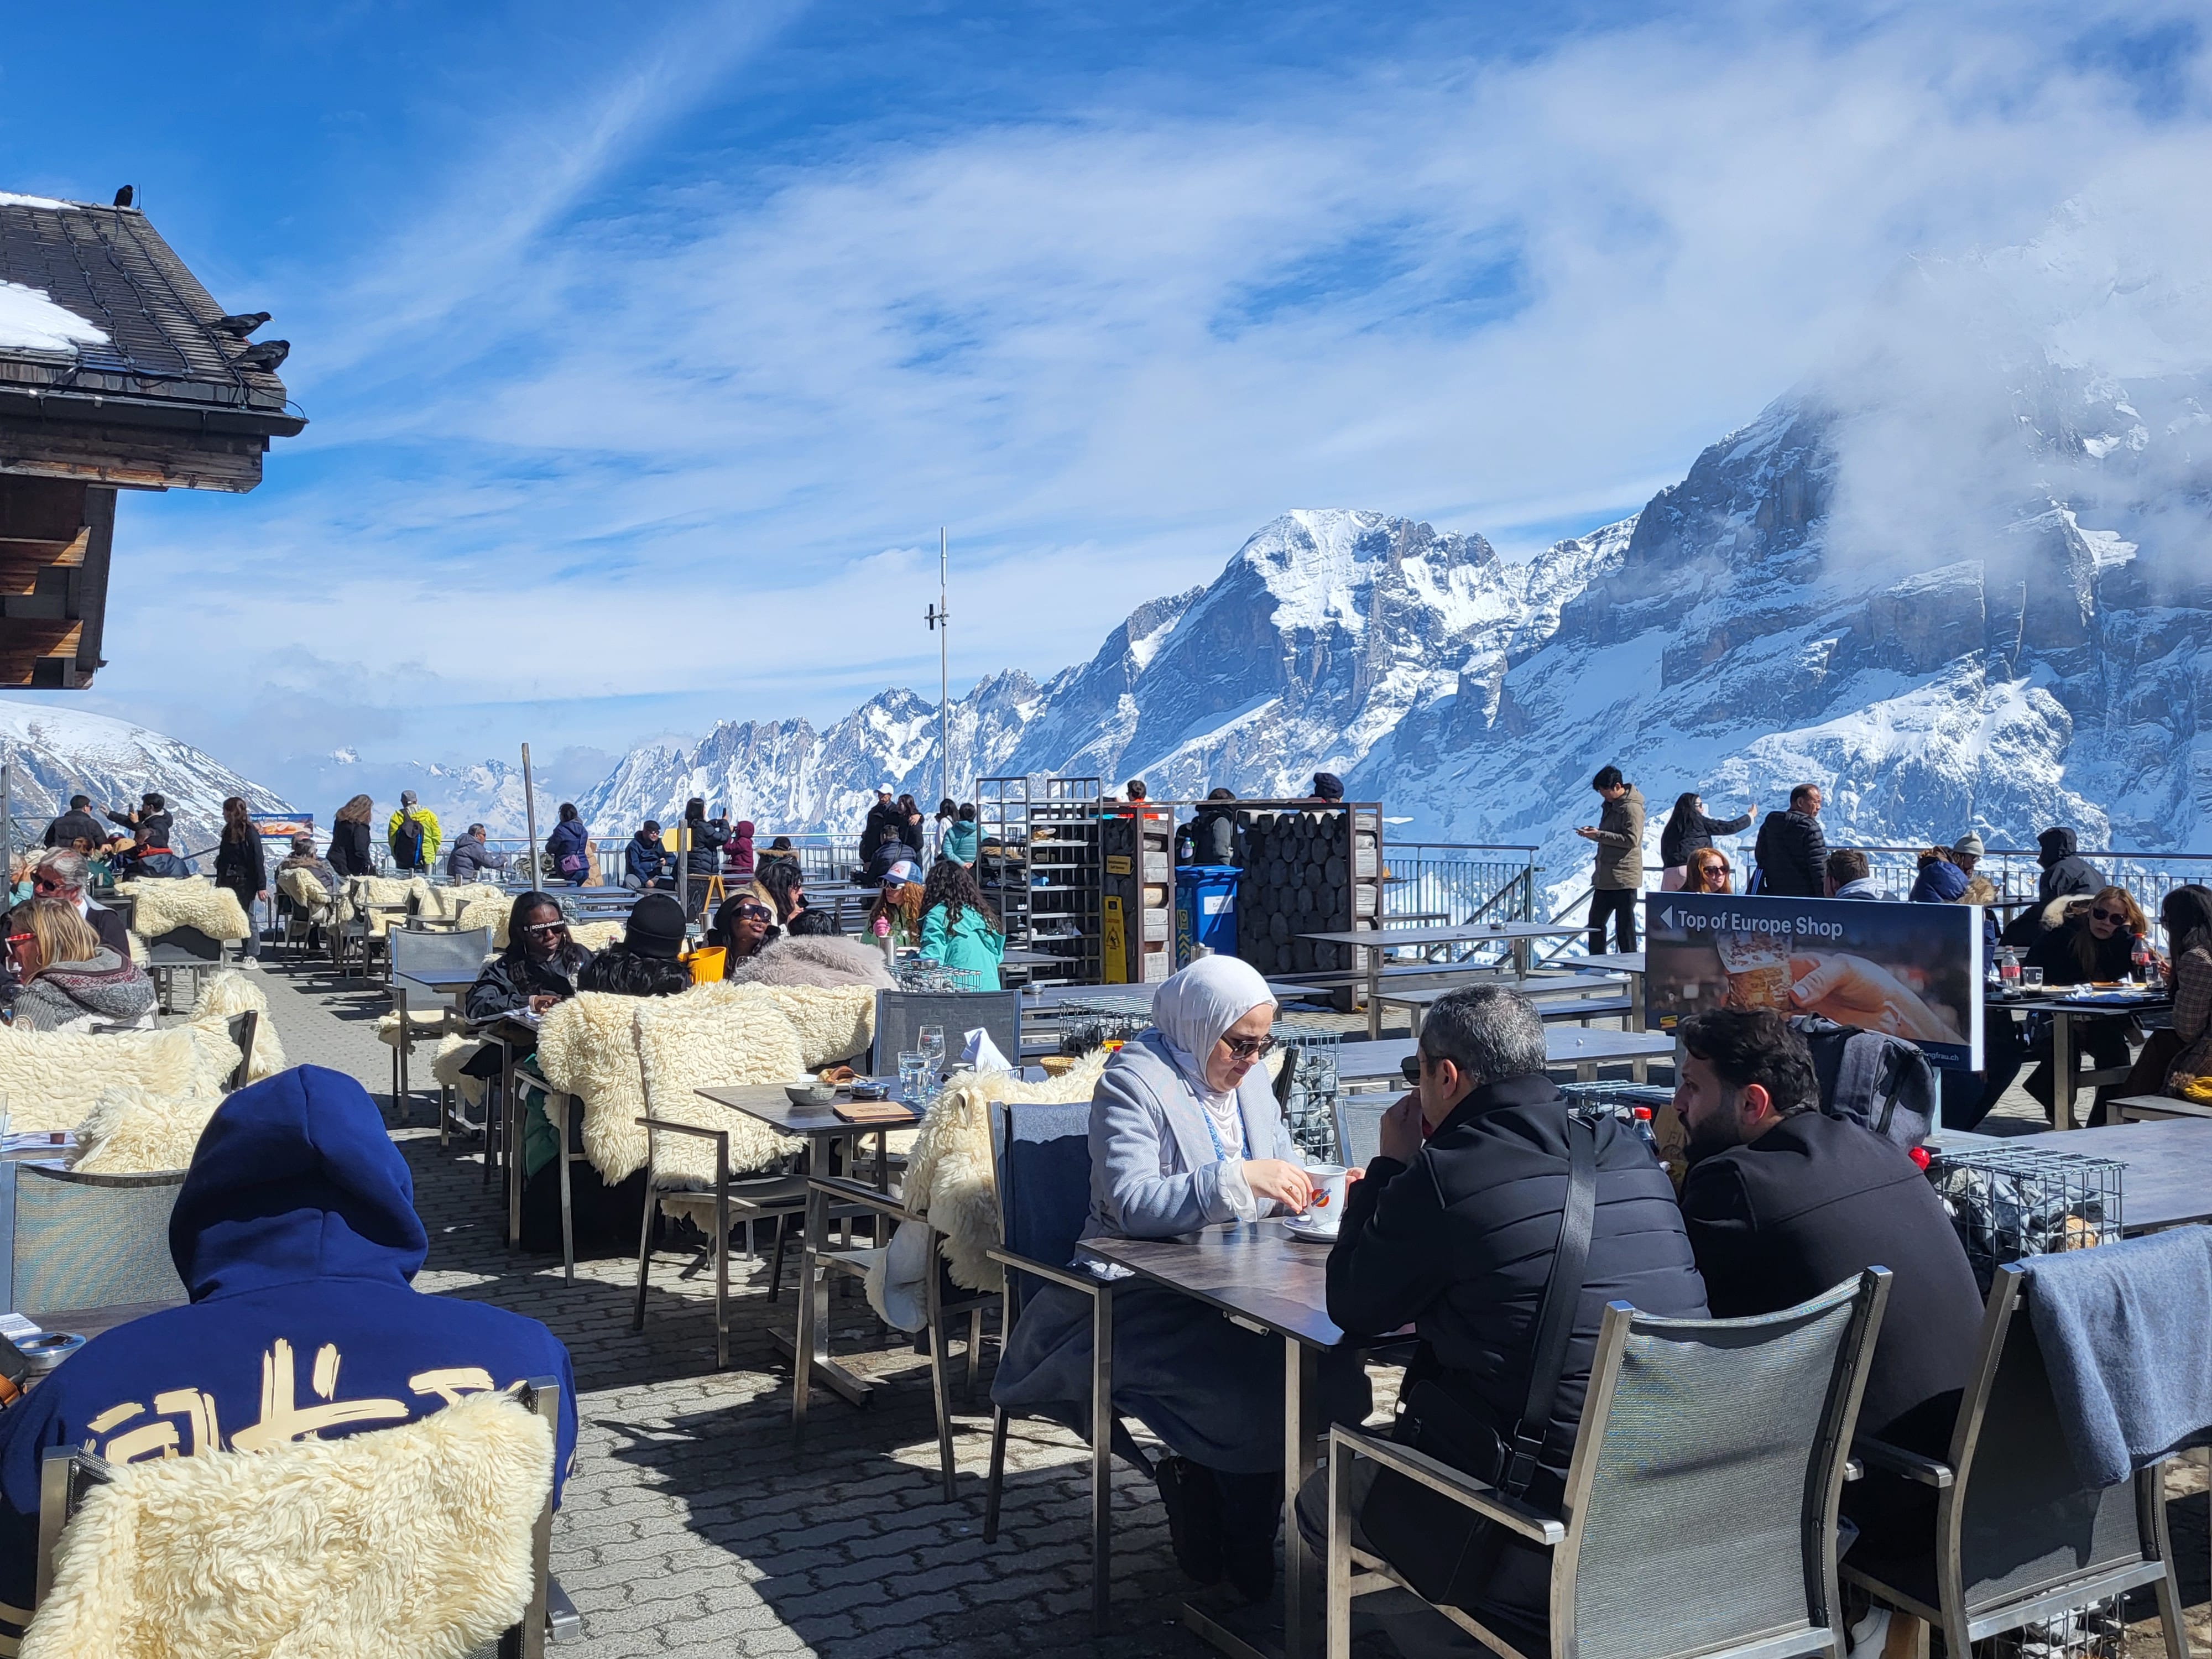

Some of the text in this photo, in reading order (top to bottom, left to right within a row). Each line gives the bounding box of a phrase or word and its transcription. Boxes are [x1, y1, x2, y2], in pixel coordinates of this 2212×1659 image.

[1678, 910, 1843, 940] Top of Europe Shop
